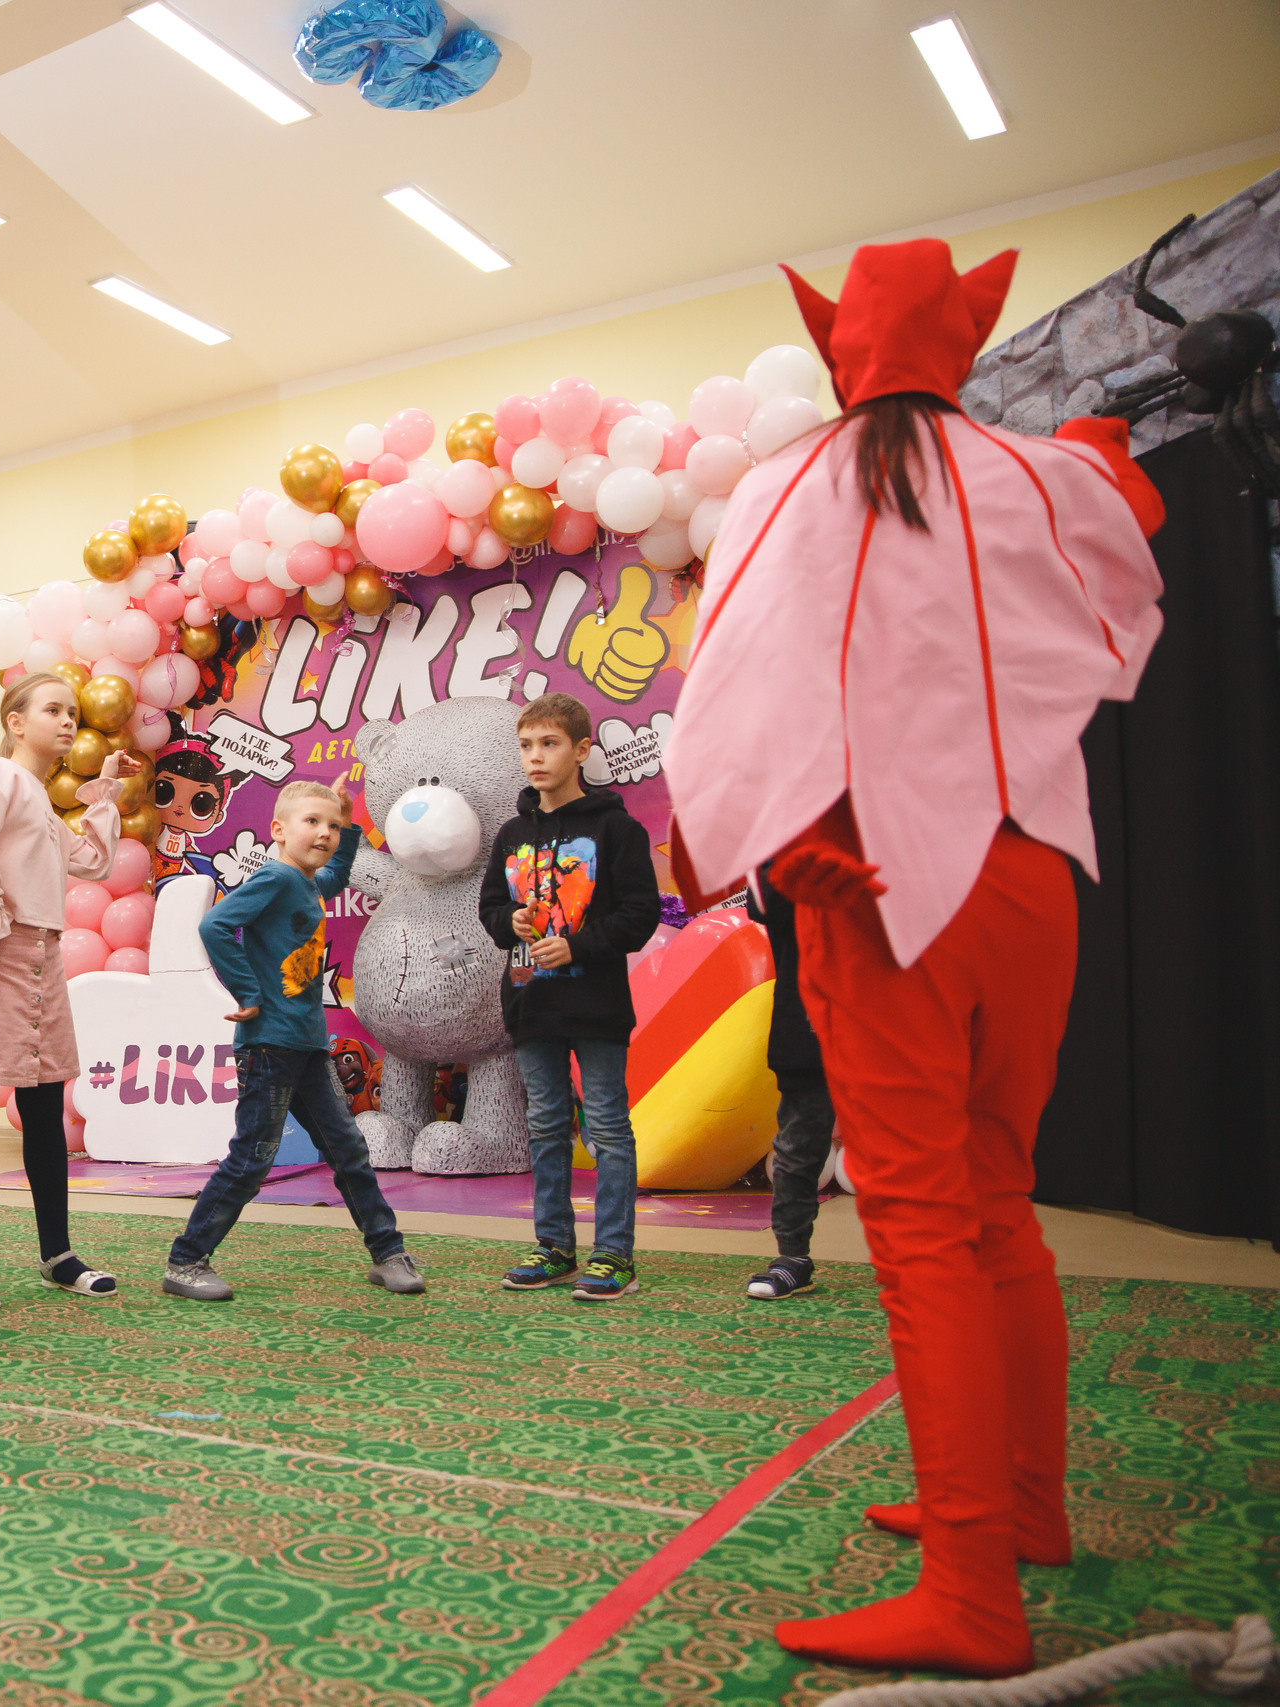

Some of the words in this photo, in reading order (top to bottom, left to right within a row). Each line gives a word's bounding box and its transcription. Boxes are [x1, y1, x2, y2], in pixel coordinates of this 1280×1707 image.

[221, 738, 278, 771] ПОДАРКИ?
[604, 731, 659, 760] НАКОЛДУЮ
[607, 740, 659, 768] КЛАССНЫЙ
[89, 1044, 238, 1105] #LiKE
